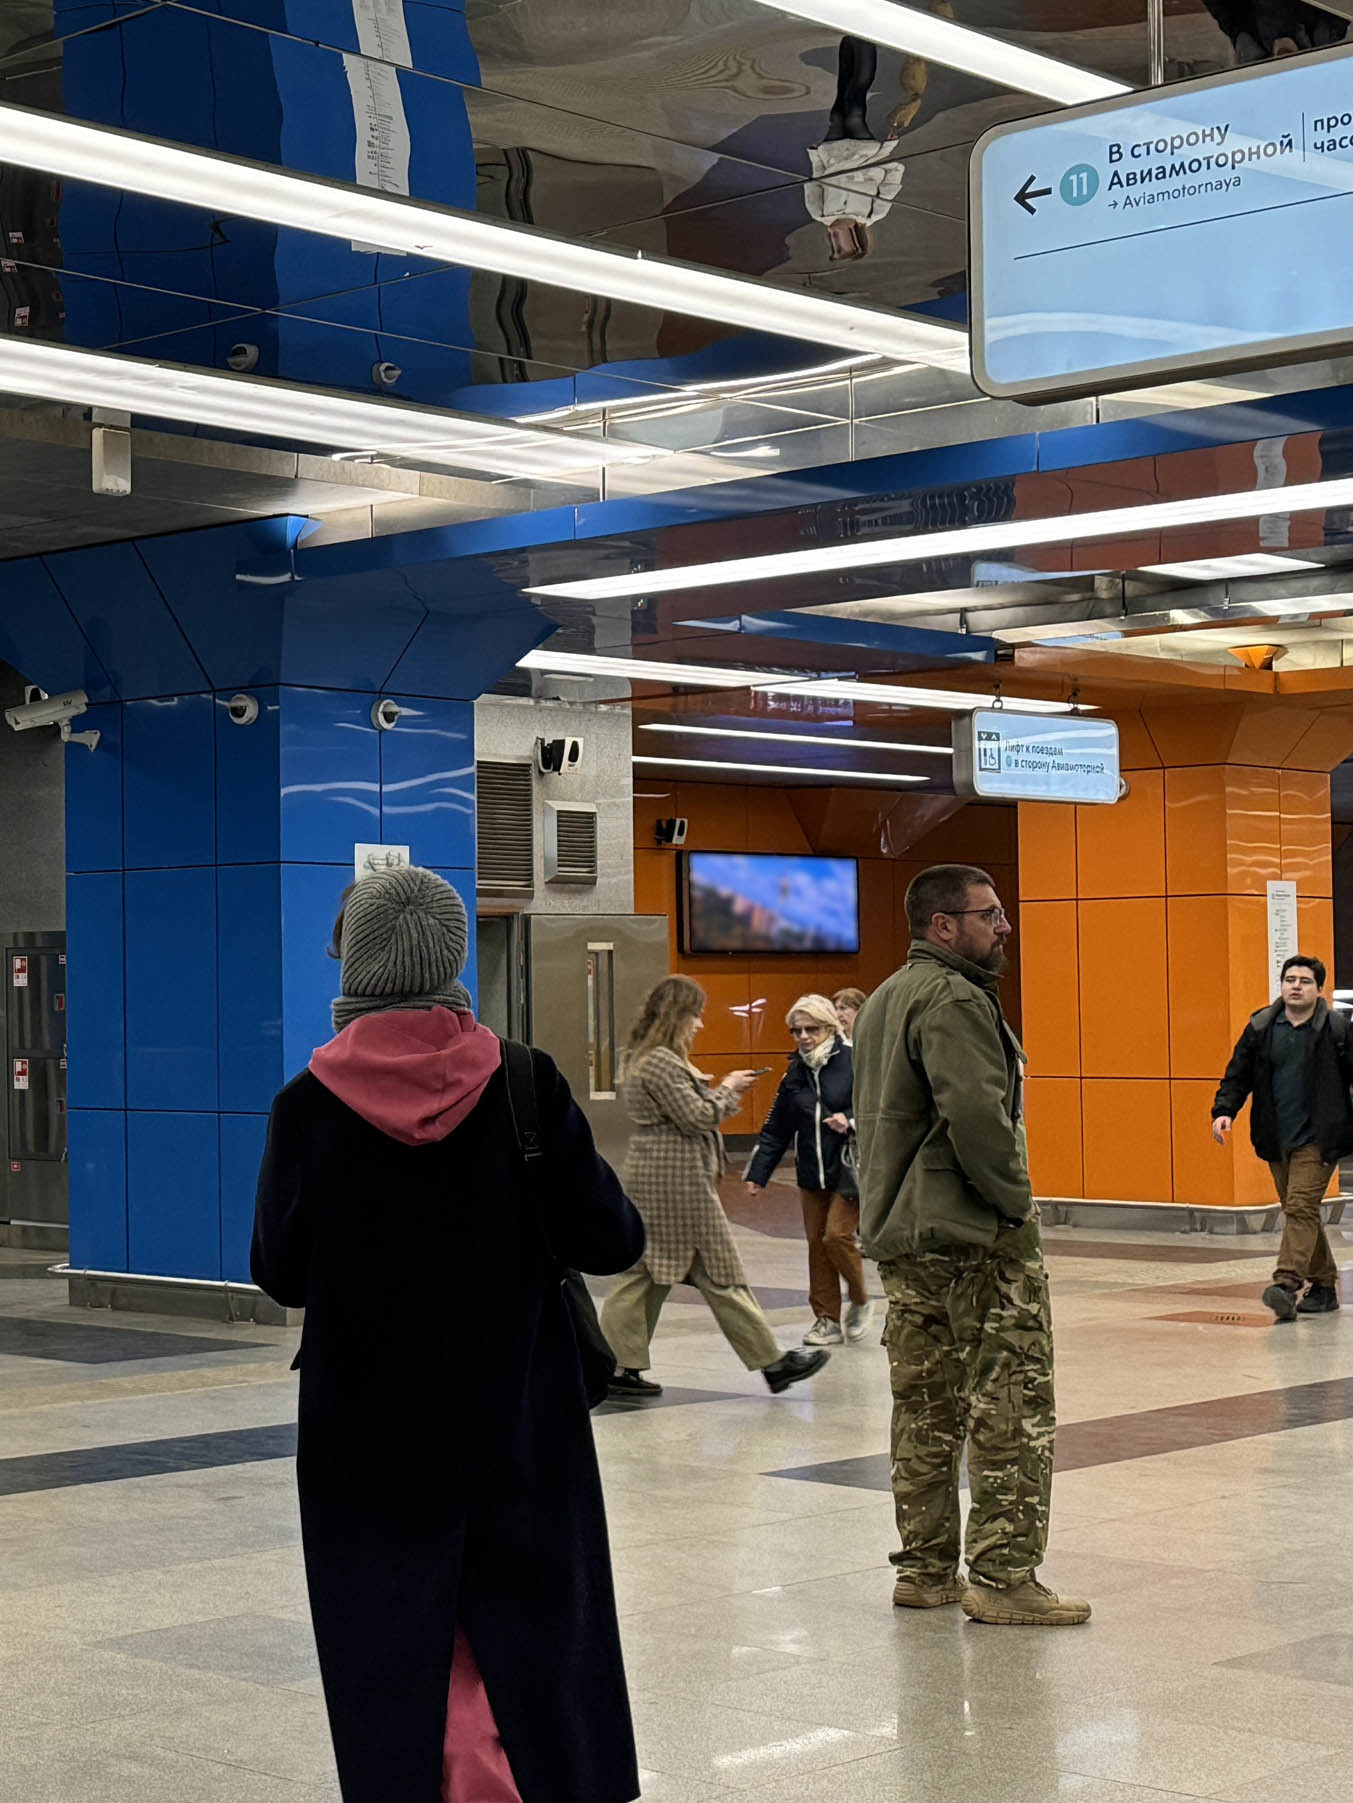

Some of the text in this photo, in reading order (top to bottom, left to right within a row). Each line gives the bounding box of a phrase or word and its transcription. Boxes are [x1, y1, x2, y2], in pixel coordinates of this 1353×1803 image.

[1107, 133, 1293, 191] Авиамоторной
[1108, 123, 1230, 164] В сторону
[1069, 172, 1089, 198] 11
[1122, 175, 1242, 210] Aviamotornaya
